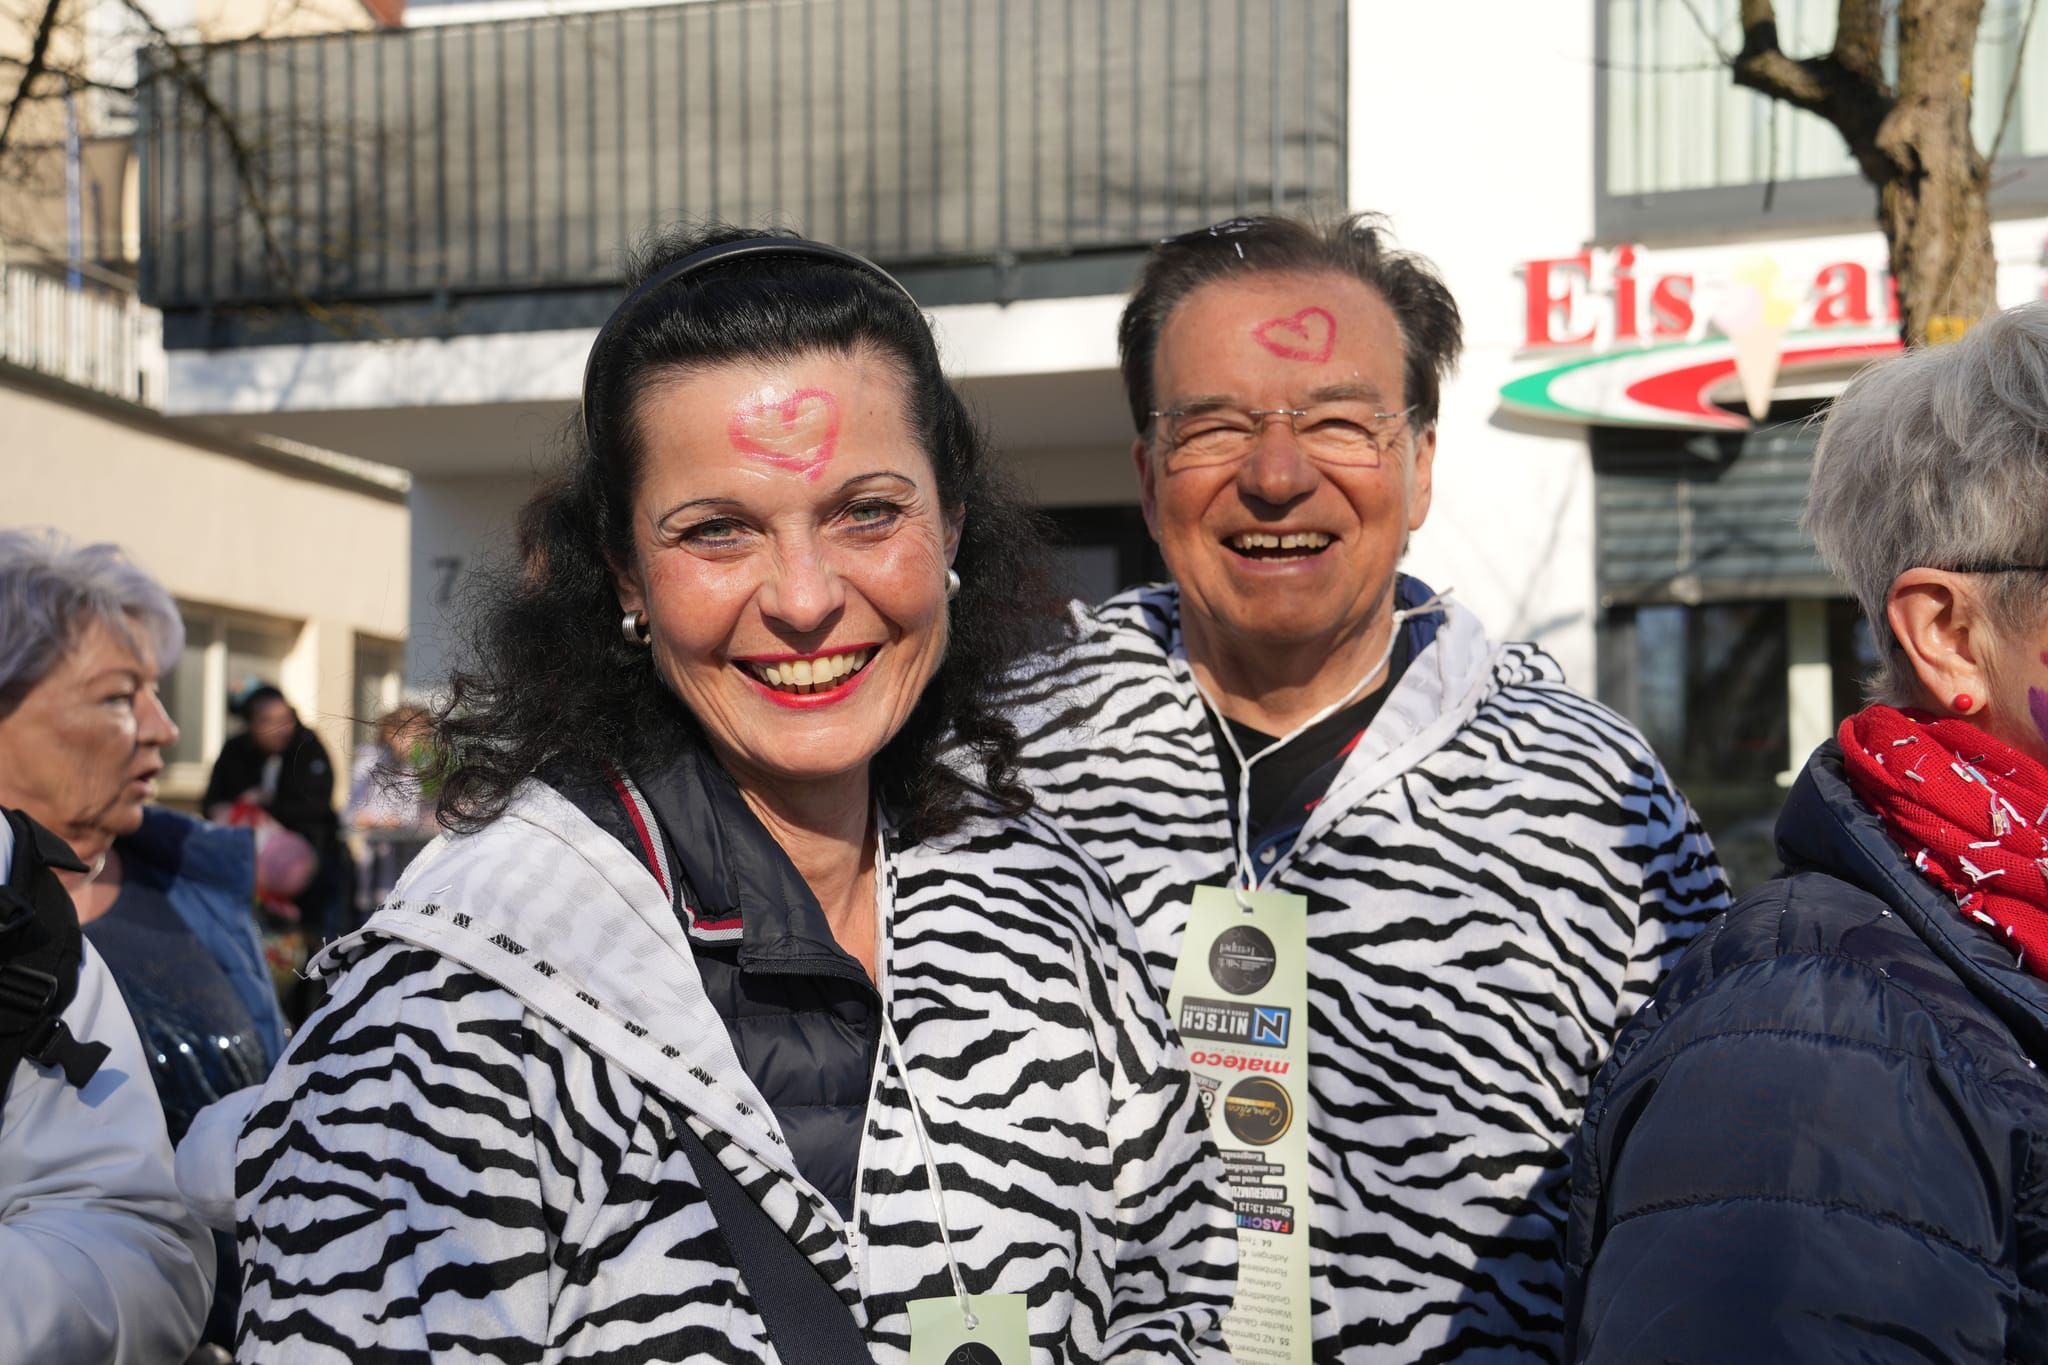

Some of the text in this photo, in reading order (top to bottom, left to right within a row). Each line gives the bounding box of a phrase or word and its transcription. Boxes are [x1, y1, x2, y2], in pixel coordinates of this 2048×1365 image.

[1523, 243, 1694, 347] Eis
[1182, 1010, 1248, 1036] NITSCH
[1190, 1050, 1290, 1076] mateco
[1239, 1202, 1264, 1214] 13:13
[1266, 1205, 1292, 1218] Start:
